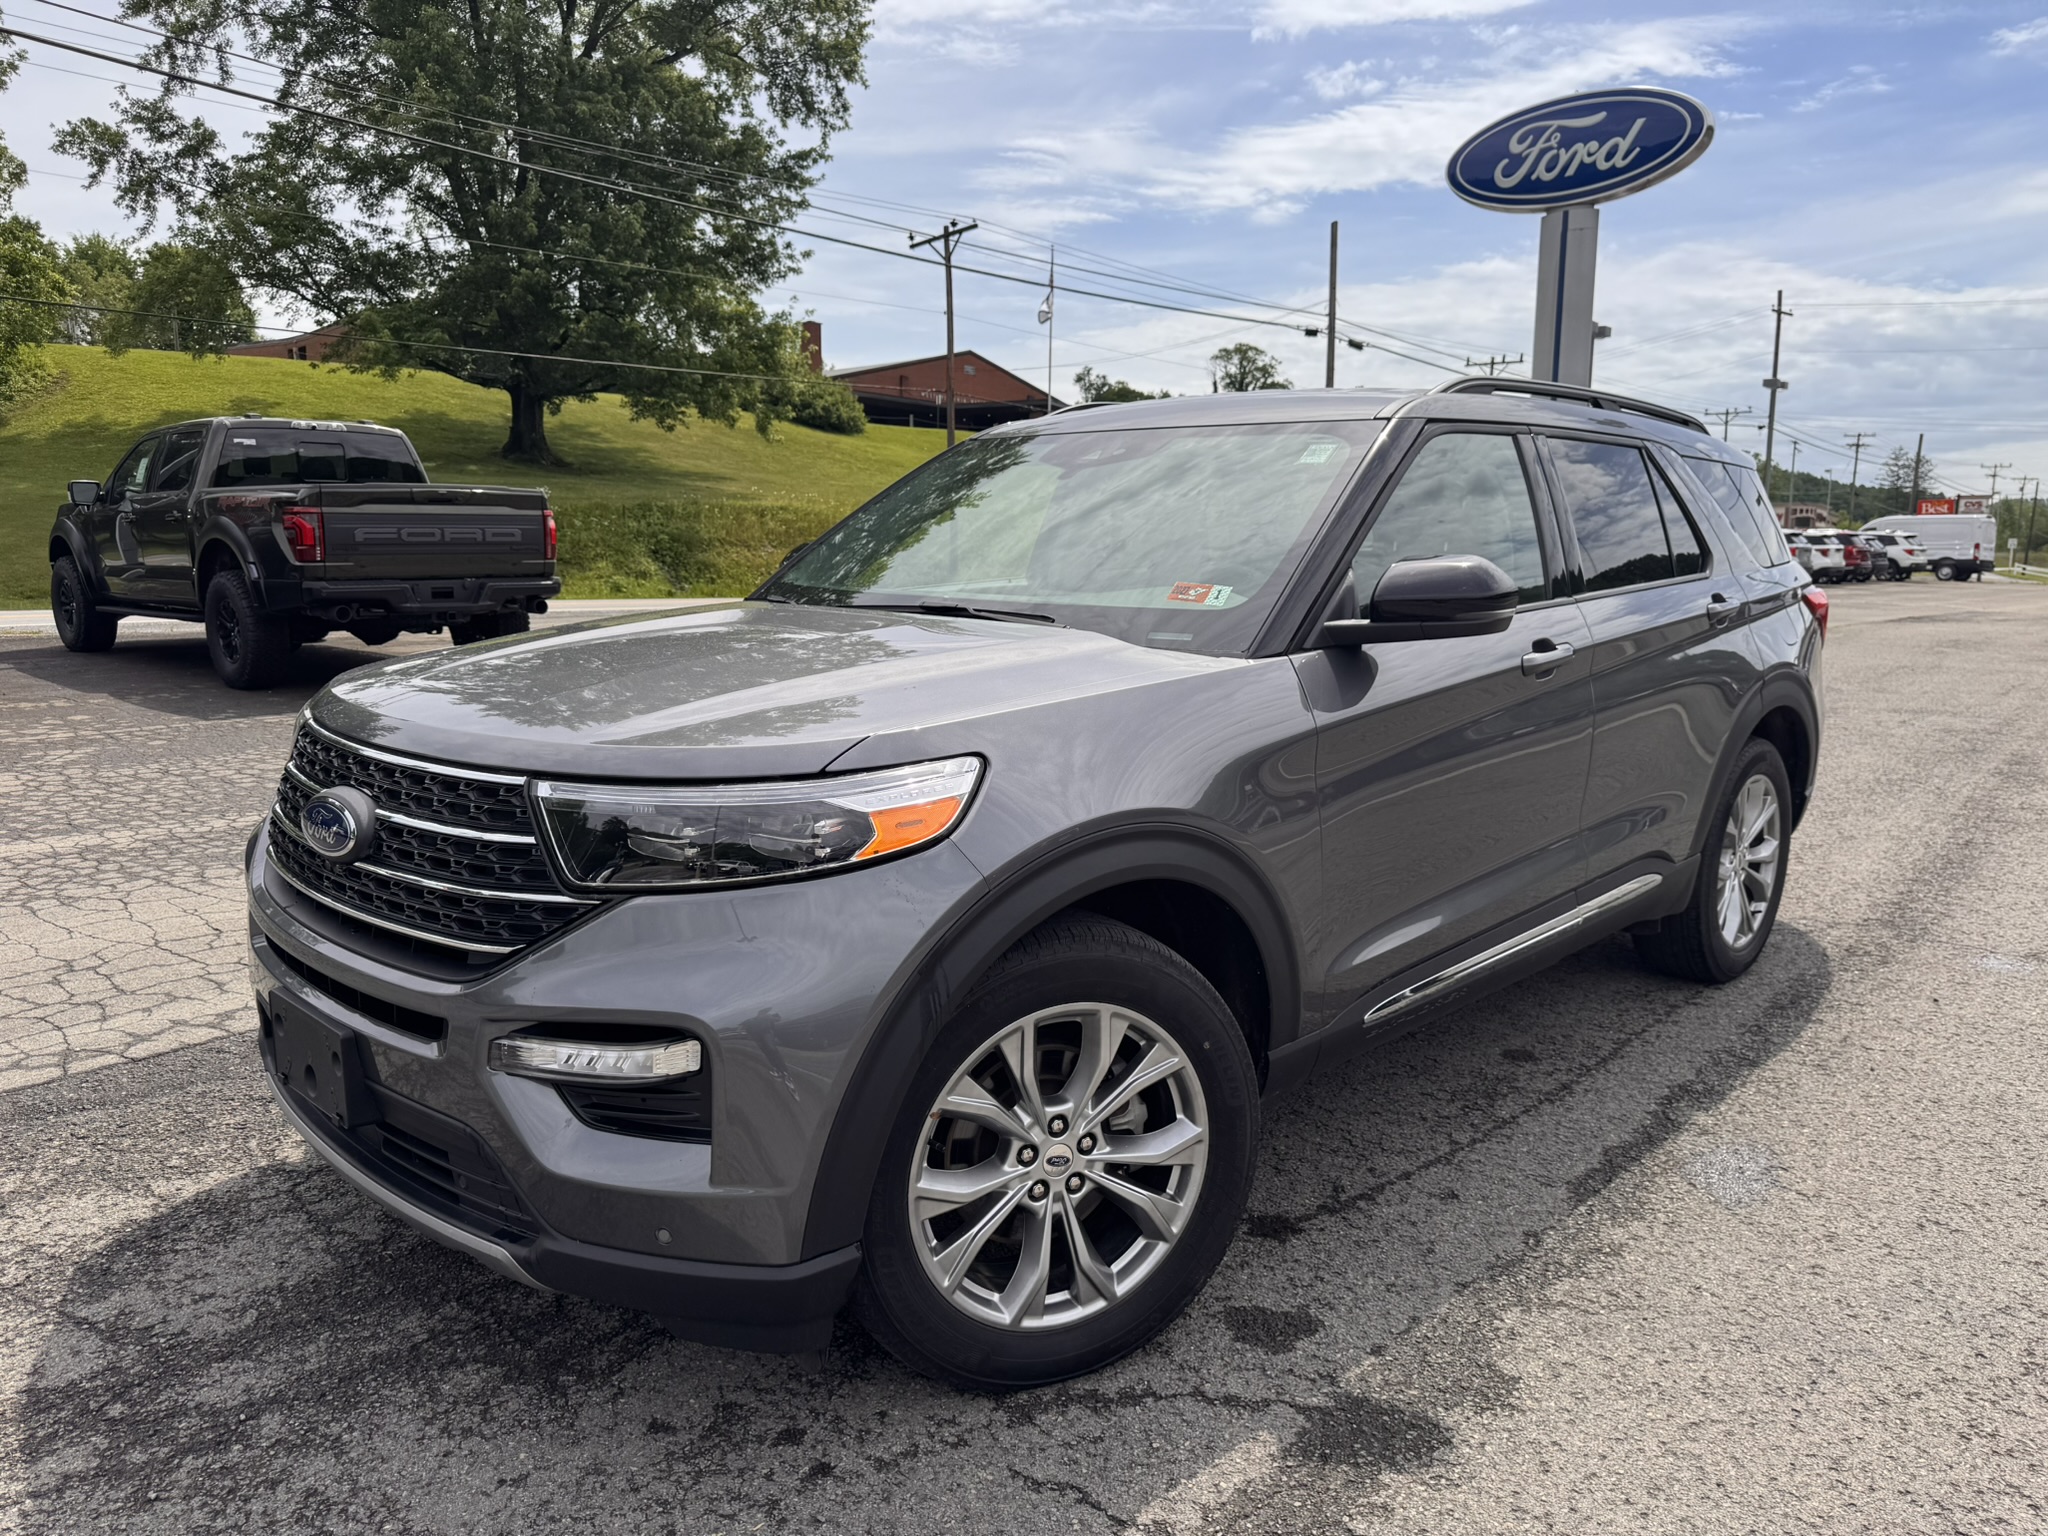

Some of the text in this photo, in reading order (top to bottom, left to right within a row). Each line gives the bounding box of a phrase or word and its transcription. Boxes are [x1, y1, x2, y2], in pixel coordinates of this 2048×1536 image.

[1493, 110, 1647, 189] Ford
[1921, 503, 1949, 514] Best
[354, 528, 522, 542] FORD
[307, 807, 339, 845] Ford
